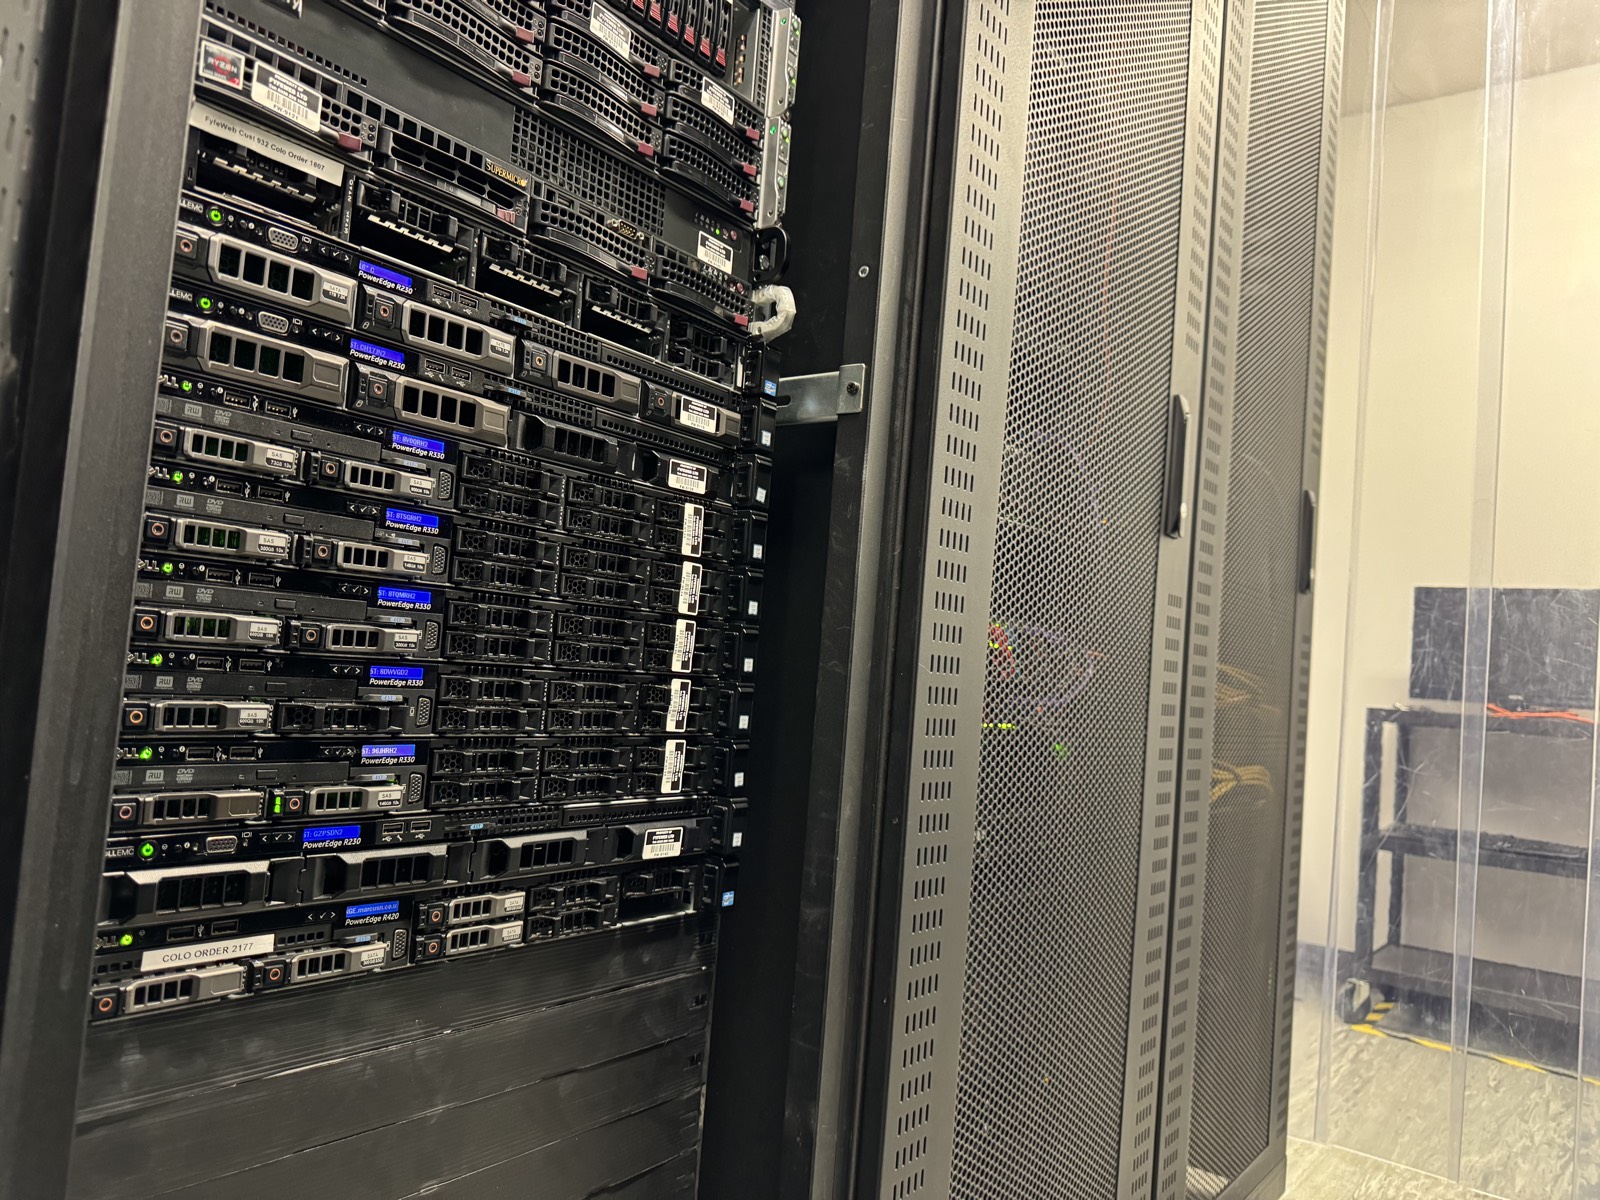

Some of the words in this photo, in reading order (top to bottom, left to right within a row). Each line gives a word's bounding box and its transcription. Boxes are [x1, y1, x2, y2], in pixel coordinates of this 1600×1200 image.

[296, 91, 308, 101] LTD
[204, 115, 237, 135] FyfeWeb
[238, 129, 256, 142] Cust
[270, 142, 287, 156] Colo
[288, 150, 308, 164] Order
[358, 270, 396, 289] PowerEdge
[396, 283, 413, 295] R230
[350, 348, 388, 366] PowerEdge
[388, 359, 406, 370] R230
[215, 409, 232, 418] DVD
[271, 451, 283, 459] SAS
[391, 442, 428, 457] PowerEdge
[428, 450, 445, 460] R330
[207, 498, 224, 506] DVD
[386, 510, 396, 518] ST:
[385, 520, 422, 533] PowerEdge
[422, 526, 439, 535] R330
[378, 589, 388, 597] ST:
[377, 598, 414, 610] PowerEdge
[414, 602, 432, 611] R330
[369, 677, 407, 688] PowerEdge
[407, 679, 424, 687] R330
[361, 747, 371, 755] ST:
[360, 756, 398, 766] PowerEdge
[398, 756, 416, 764] R330
[302, 839, 343, 850] PowerEdge
[343, 837, 362, 847] R230
[344, 915, 382, 927] PowerEdge
[382, 912, 400, 922] R420
[162, 952, 191, 964] COLO
[194, 946, 229, 959] ORDER
[231, 942, 254, 954] 2177
